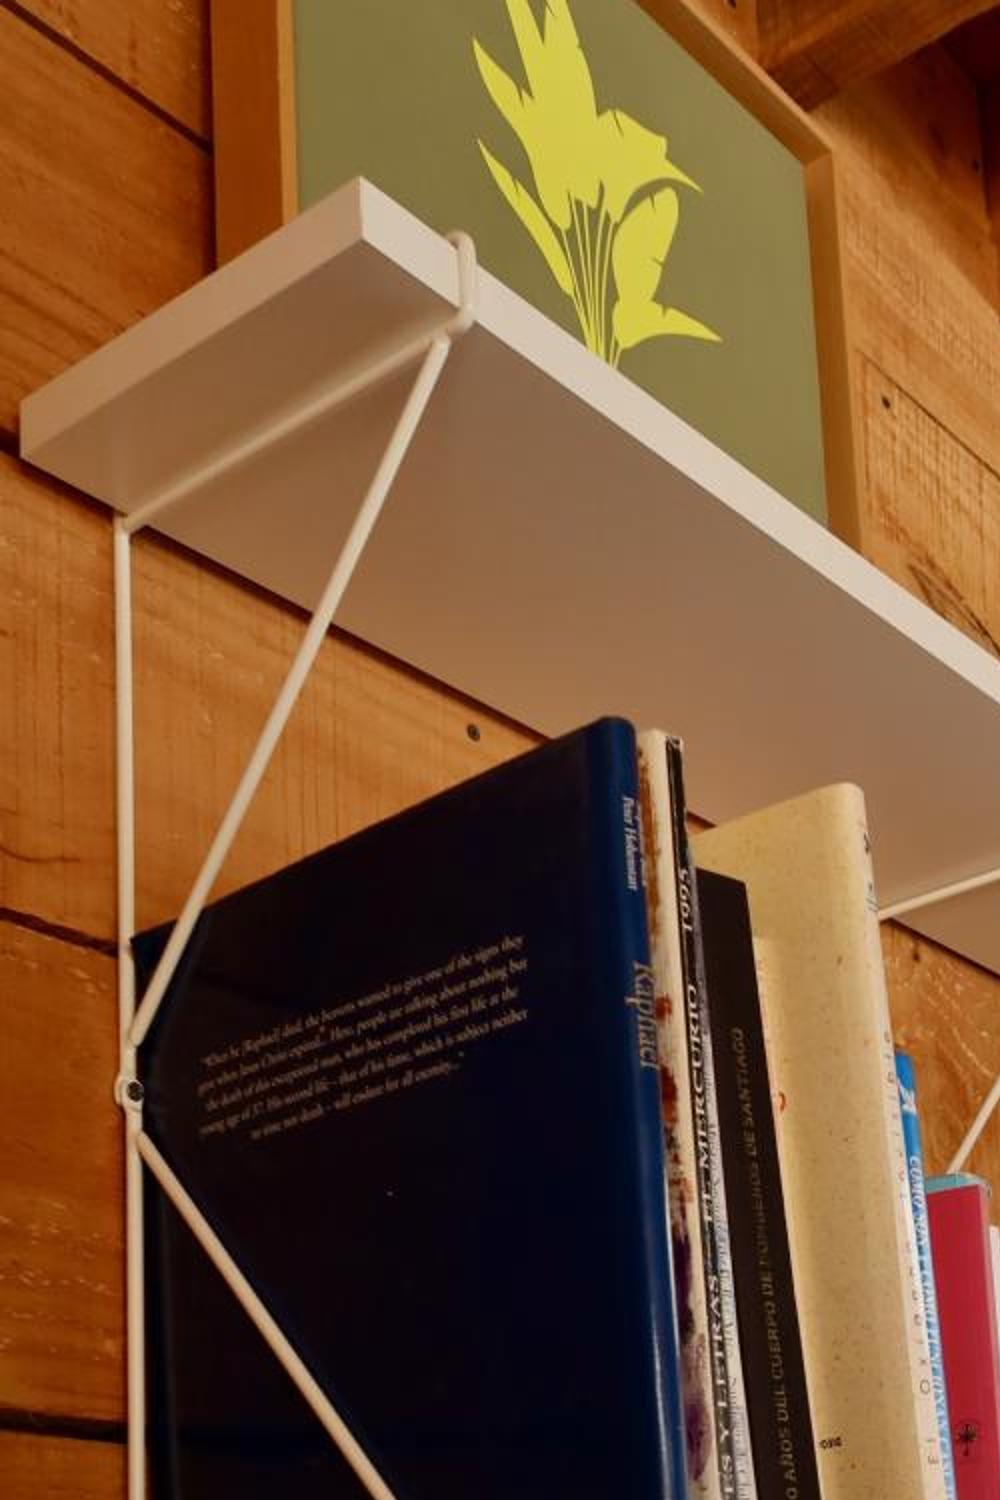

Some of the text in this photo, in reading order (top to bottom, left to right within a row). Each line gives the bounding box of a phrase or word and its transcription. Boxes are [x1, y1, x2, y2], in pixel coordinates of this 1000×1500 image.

[680, 866, 694, 932] 1995
[687, 984, 711, 1168] MERCURIO
[731, 1027, 755, 1128] SANTIAGO
[709, 1275, 727, 1408] LETRAS
[767, 1302, 784, 1379] CUERPO
[719, 1428, 730, 1445] Y
